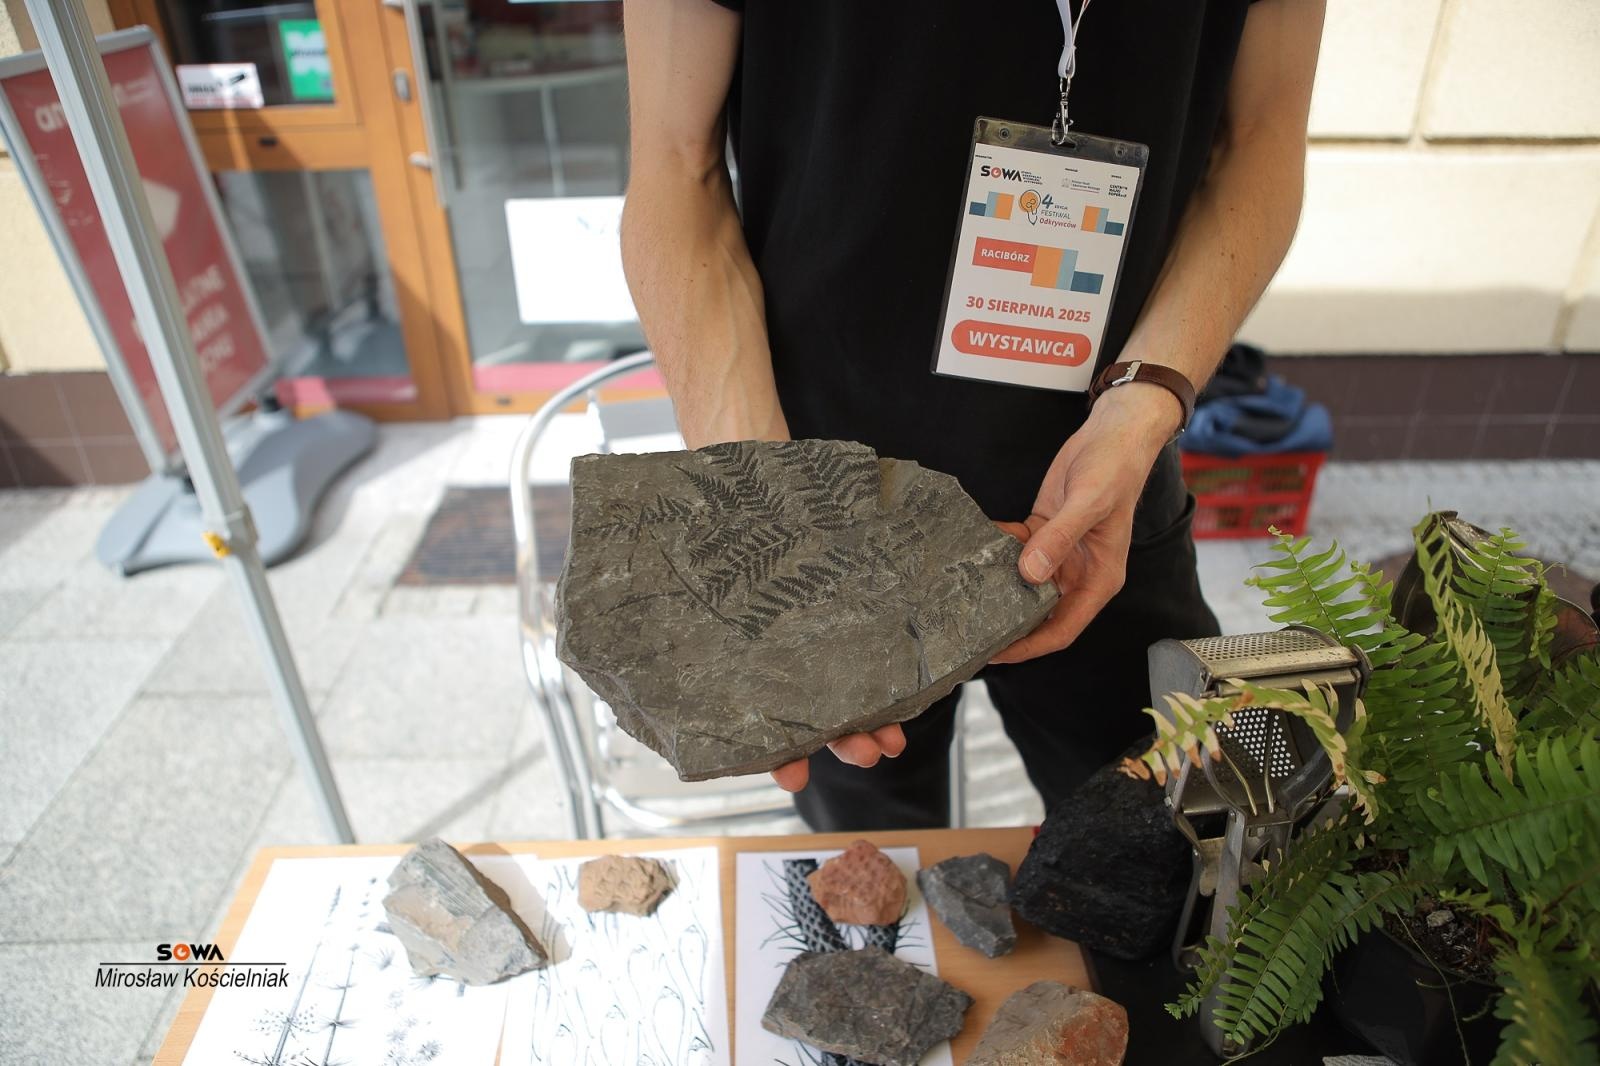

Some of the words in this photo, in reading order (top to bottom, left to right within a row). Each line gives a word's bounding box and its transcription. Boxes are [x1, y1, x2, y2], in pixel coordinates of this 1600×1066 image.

[981, 165, 1022, 182] SOWA
[1042, 193, 1054, 209] 4
[1040, 209, 1071, 219] FESTIWAL
[1039, 217, 1077, 229] Odkrywców
[981, 247, 1031, 263] RACIBÓRZ
[966, 296, 984, 310] 30
[988, 299, 1055, 319] SIERPNIA
[1058, 309, 1091, 323] 2025
[969, 330, 1076, 358] WYSTAWCA
